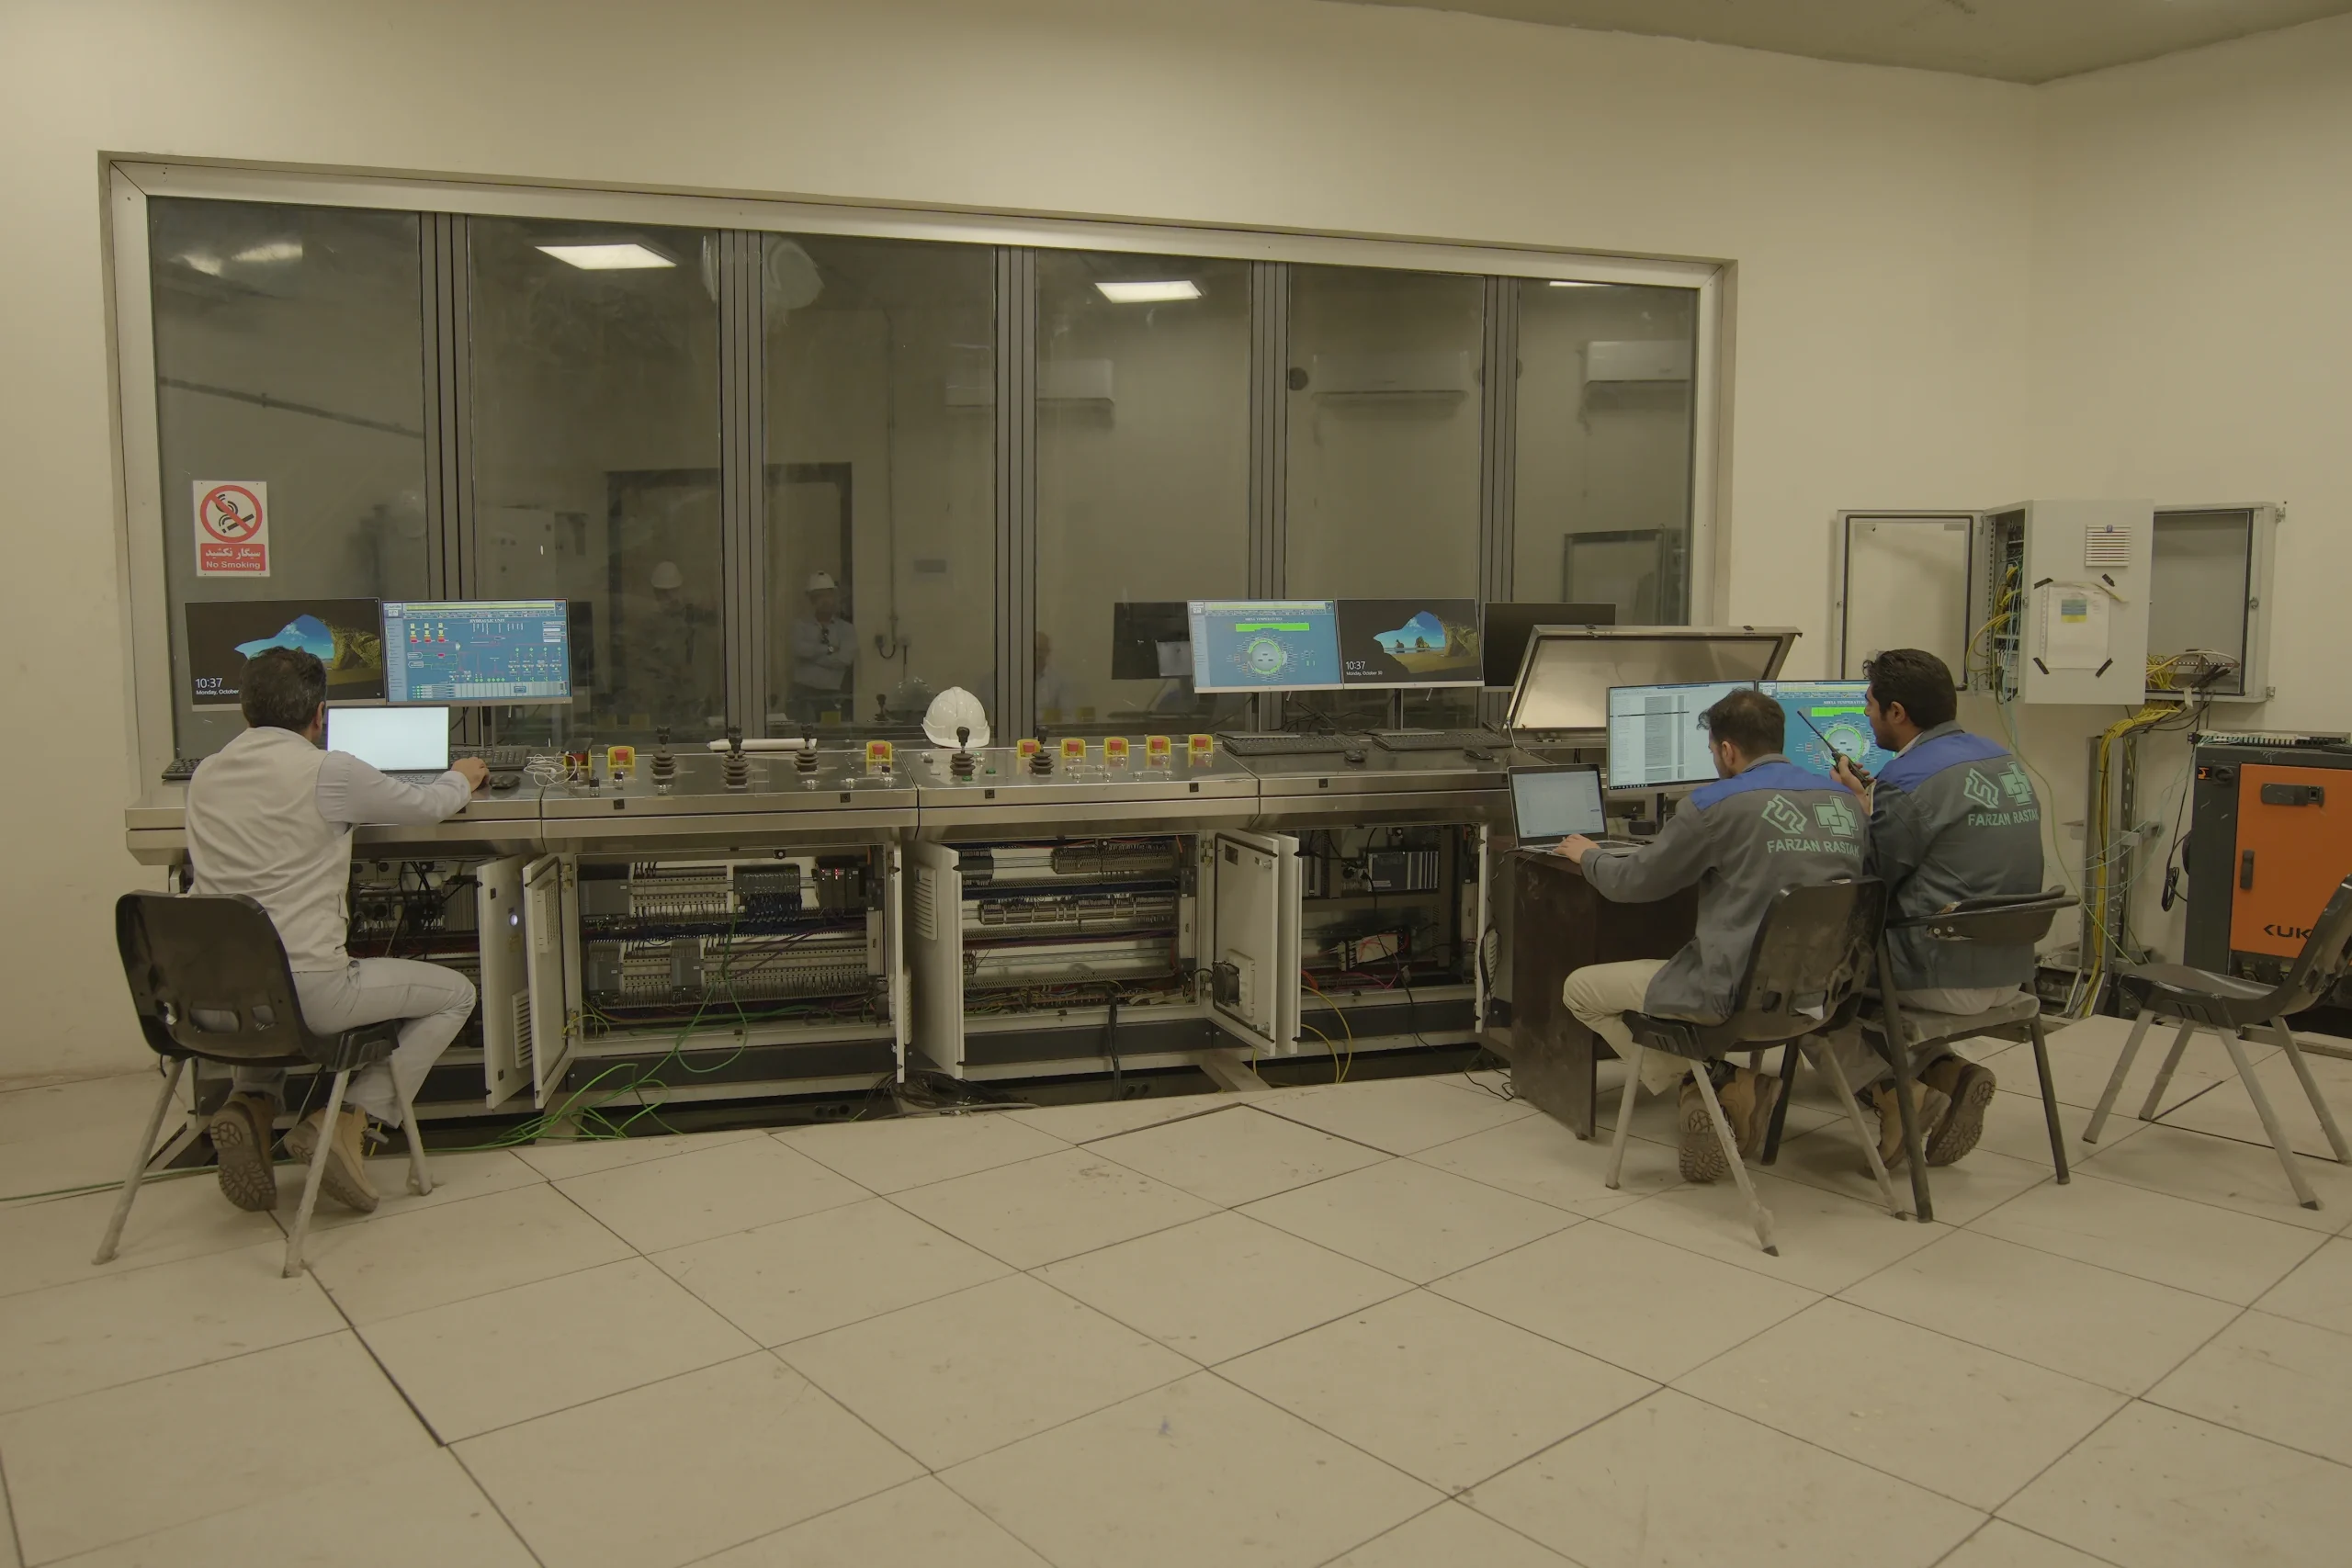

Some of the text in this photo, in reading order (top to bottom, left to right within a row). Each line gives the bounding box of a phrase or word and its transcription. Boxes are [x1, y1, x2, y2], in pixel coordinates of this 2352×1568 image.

[205, 547, 261, 559] سیگار نکشید
[221, 561, 261, 570] Smoking
[1346, 660, 1366, 671] 10:37
[195, 677, 223, 689] 10:37
[1968, 812, 2011, 826] FARZAN
[1767, 838, 1860, 857] FARZAN RASTAK
[2263, 924, 2312, 939] KUK
